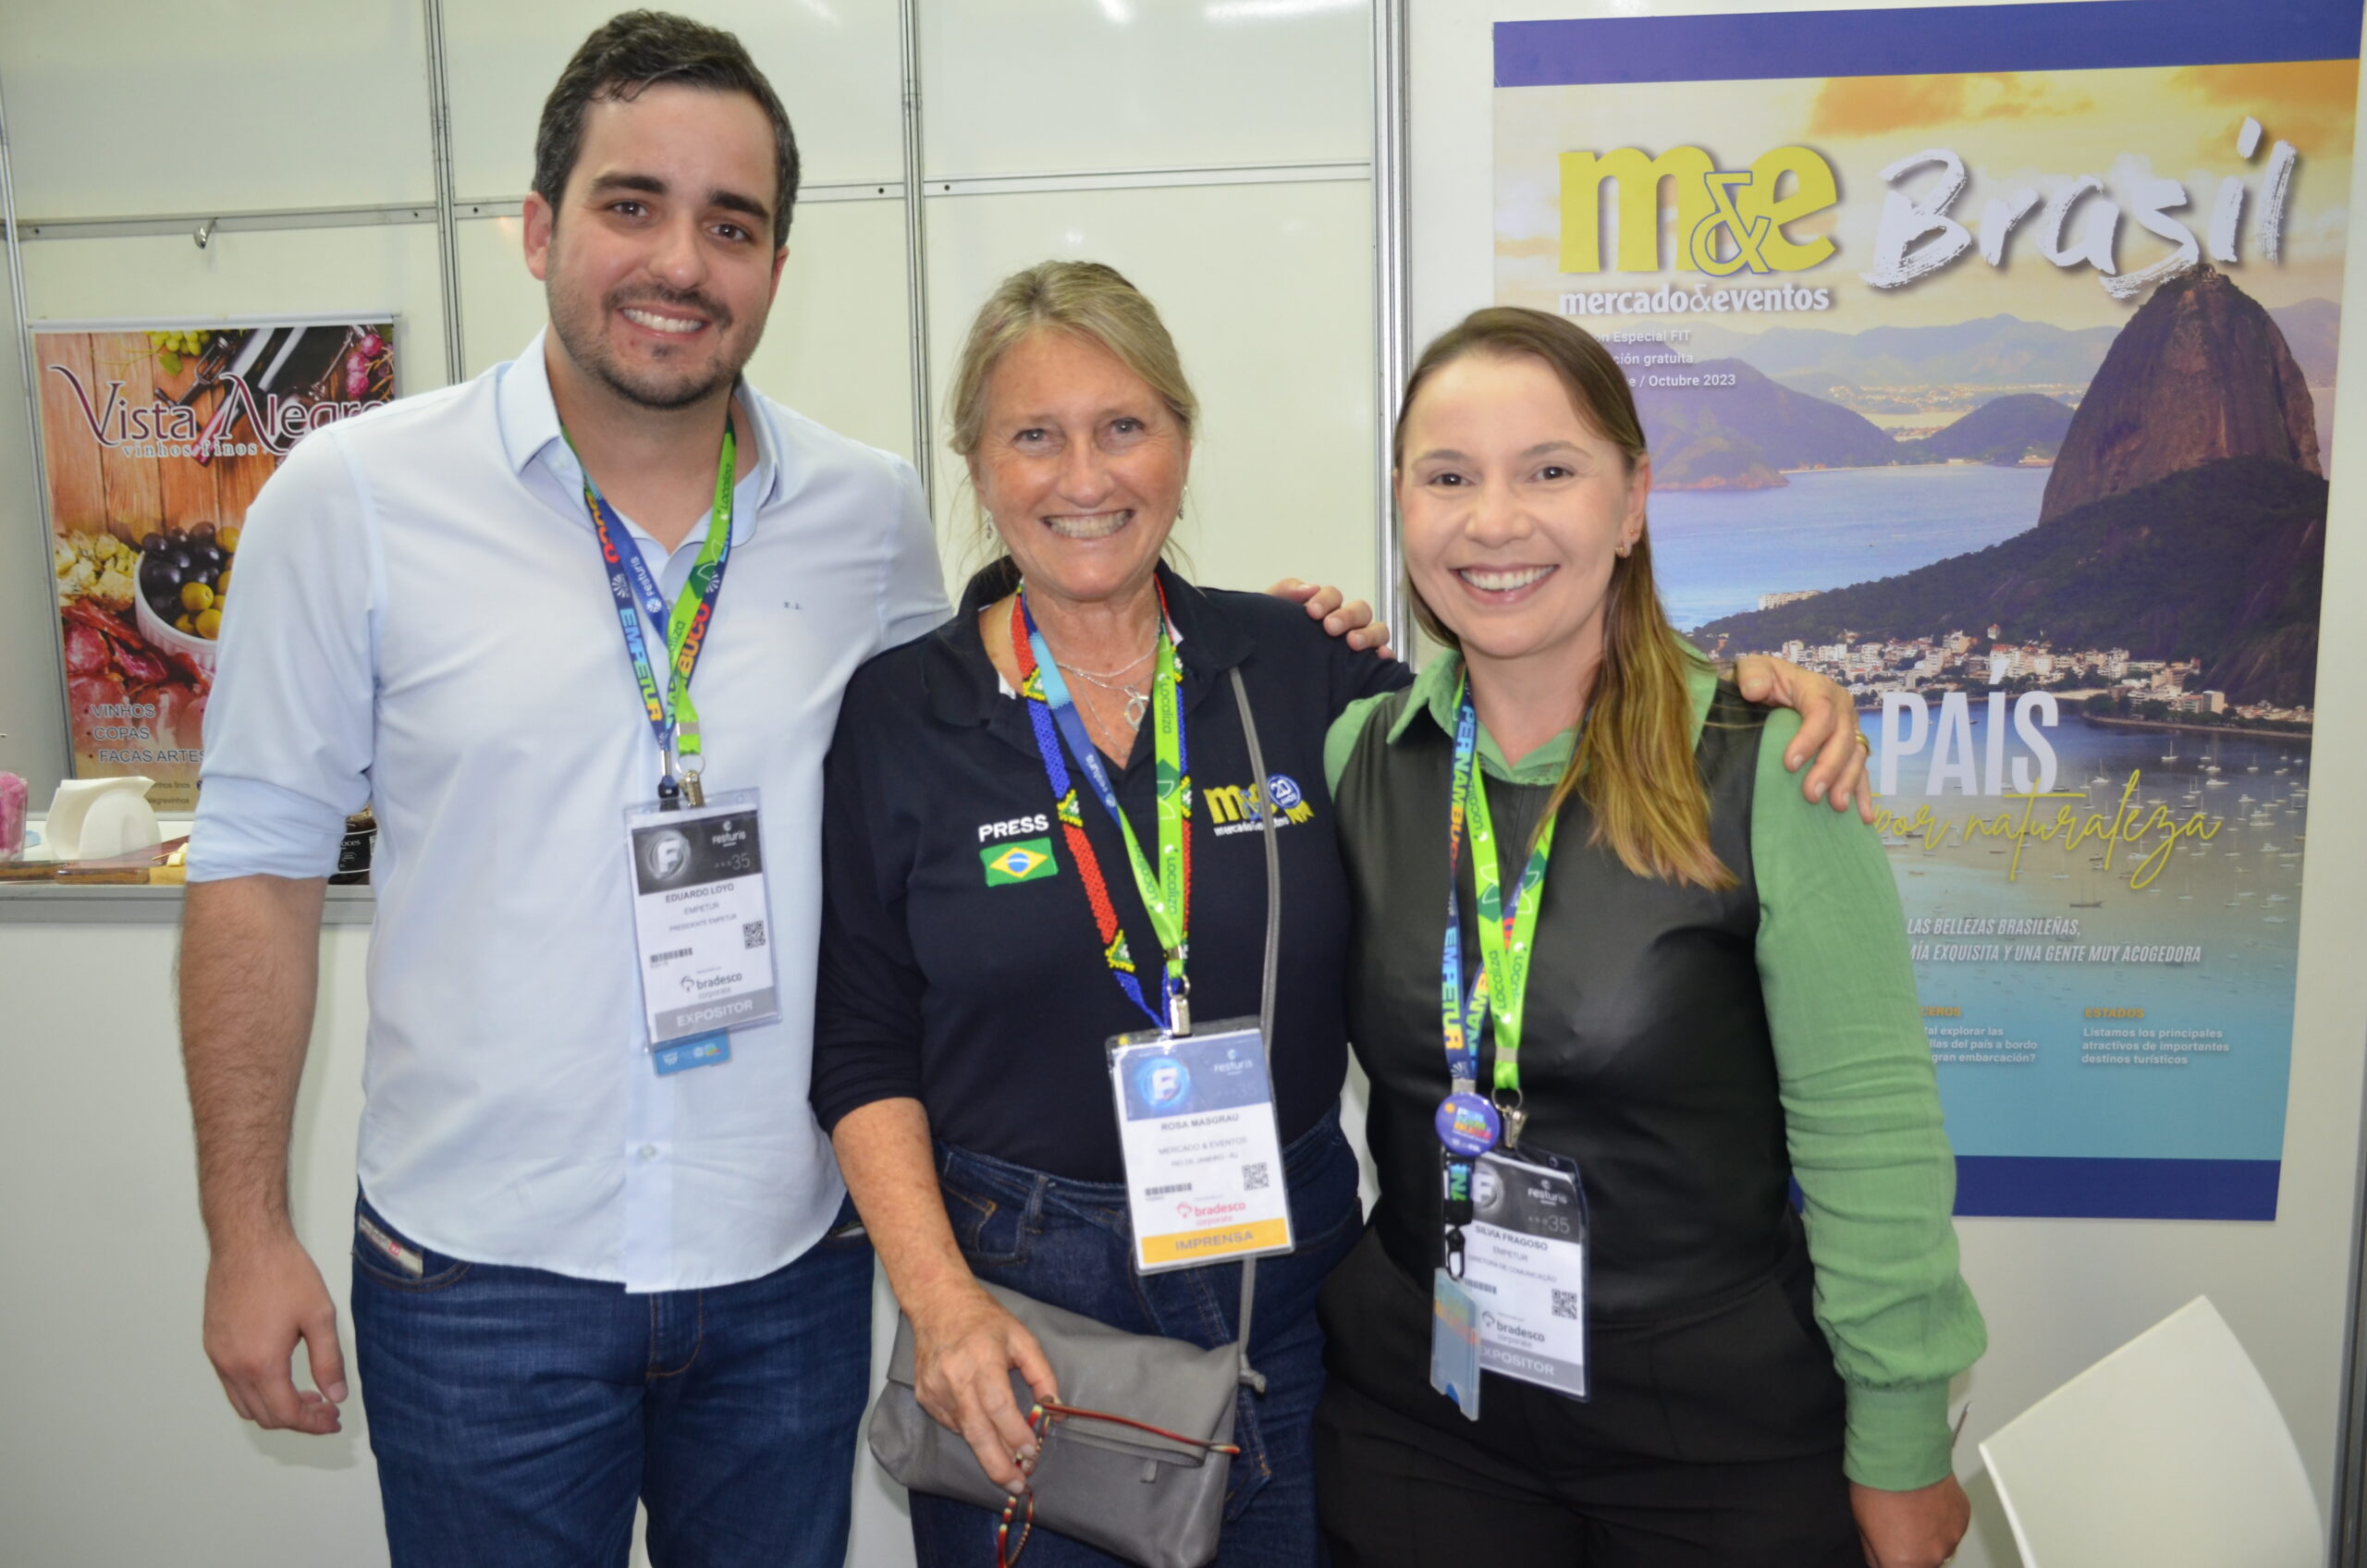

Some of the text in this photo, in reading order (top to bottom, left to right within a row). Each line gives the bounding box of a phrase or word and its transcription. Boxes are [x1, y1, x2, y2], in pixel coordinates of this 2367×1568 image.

[1558, 145, 1838, 277] m&e
[1860, 116, 2297, 300] Brasil
[1558, 284, 1830, 315] mercado&eventos
[1613, 330, 1667, 345] Especial
[1670, 330, 1691, 342] FIT
[1644, 353, 1694, 367] gratuita
[1649, 374, 1699, 386] Octubre
[1703, 374, 1736, 386] 2023
[49, 365, 197, 447] Vista
[123, 439, 258, 459] vinhos finos
[677, 602, 713, 674] BUCO
[619, 607, 664, 722] EMPETUR
[92, 704, 156, 719] VINHOS
[93, 727, 151, 741] COPAS
[1880, 659, 2059, 796] PAÍS
[98, 749, 153, 764] FACAS
[978, 814, 1049, 843] PRESS
[1966, 768, 2221, 889] naturaleza
[731, 852, 751, 871] 35
[665, 883, 734, 903] EDUARDO LOYO
[1165, 857, 1178, 915] Localiza
[683, 901, 720, 915] EMPETUR
[1907, 916, 2081, 937] LAS BELLEZAS BRASILEÑAS,
[1933, 944, 1999, 962] EXQUISITA
[2004, 945, 2013, 961] Y
[2014, 945, 2041, 961] UNA
[2045, 945, 2086, 962] GENTE
[2088, 946, 2121, 962] MUY
[2121, 946, 2201, 962] ACOGEDORA
[696, 973, 742, 990] bradesco
[1441, 926, 1465, 1050] EMPETUR
[677, 999, 754, 1027] EXPOSITOR
[2085, 1008, 2145, 1019] ESTADOS
[1940, 1026, 1985, 1037] explorar
[1988, 1026, 2005, 1036] las
[2083, 1027, 2224, 1040] Listamos los principales
[1951, 1039, 1968, 1048] del
[1970, 1039, 1993, 1051] país
[2005, 1039, 2038, 1050] bordo
[2081, 1041, 2230, 1052] atractivos de importantes
[1932, 1052, 2036, 1064] gran embarcación?
[2081, 1053, 2189, 1065] destinos turísticos
[1160, 1113, 1240, 1132] ROSA MASGRAU
[1158, 1142, 1201, 1156] MERCADO
[1208, 1136, 1248, 1149] EVENTOS
[1195, 1202, 1246, 1218] bradesco
[1548, 1214, 1571, 1234] 35
[1175, 1230, 1254, 1251] IMPRENSA
[1475, 1225, 1549, 1252] SILVIA FRAGOSO
[1492, 1246, 1529, 1263] EMPETUR
[1496, 1321, 1546, 1342] bradesco
[1479, 1346, 1555, 1377] EXPOSITOR
